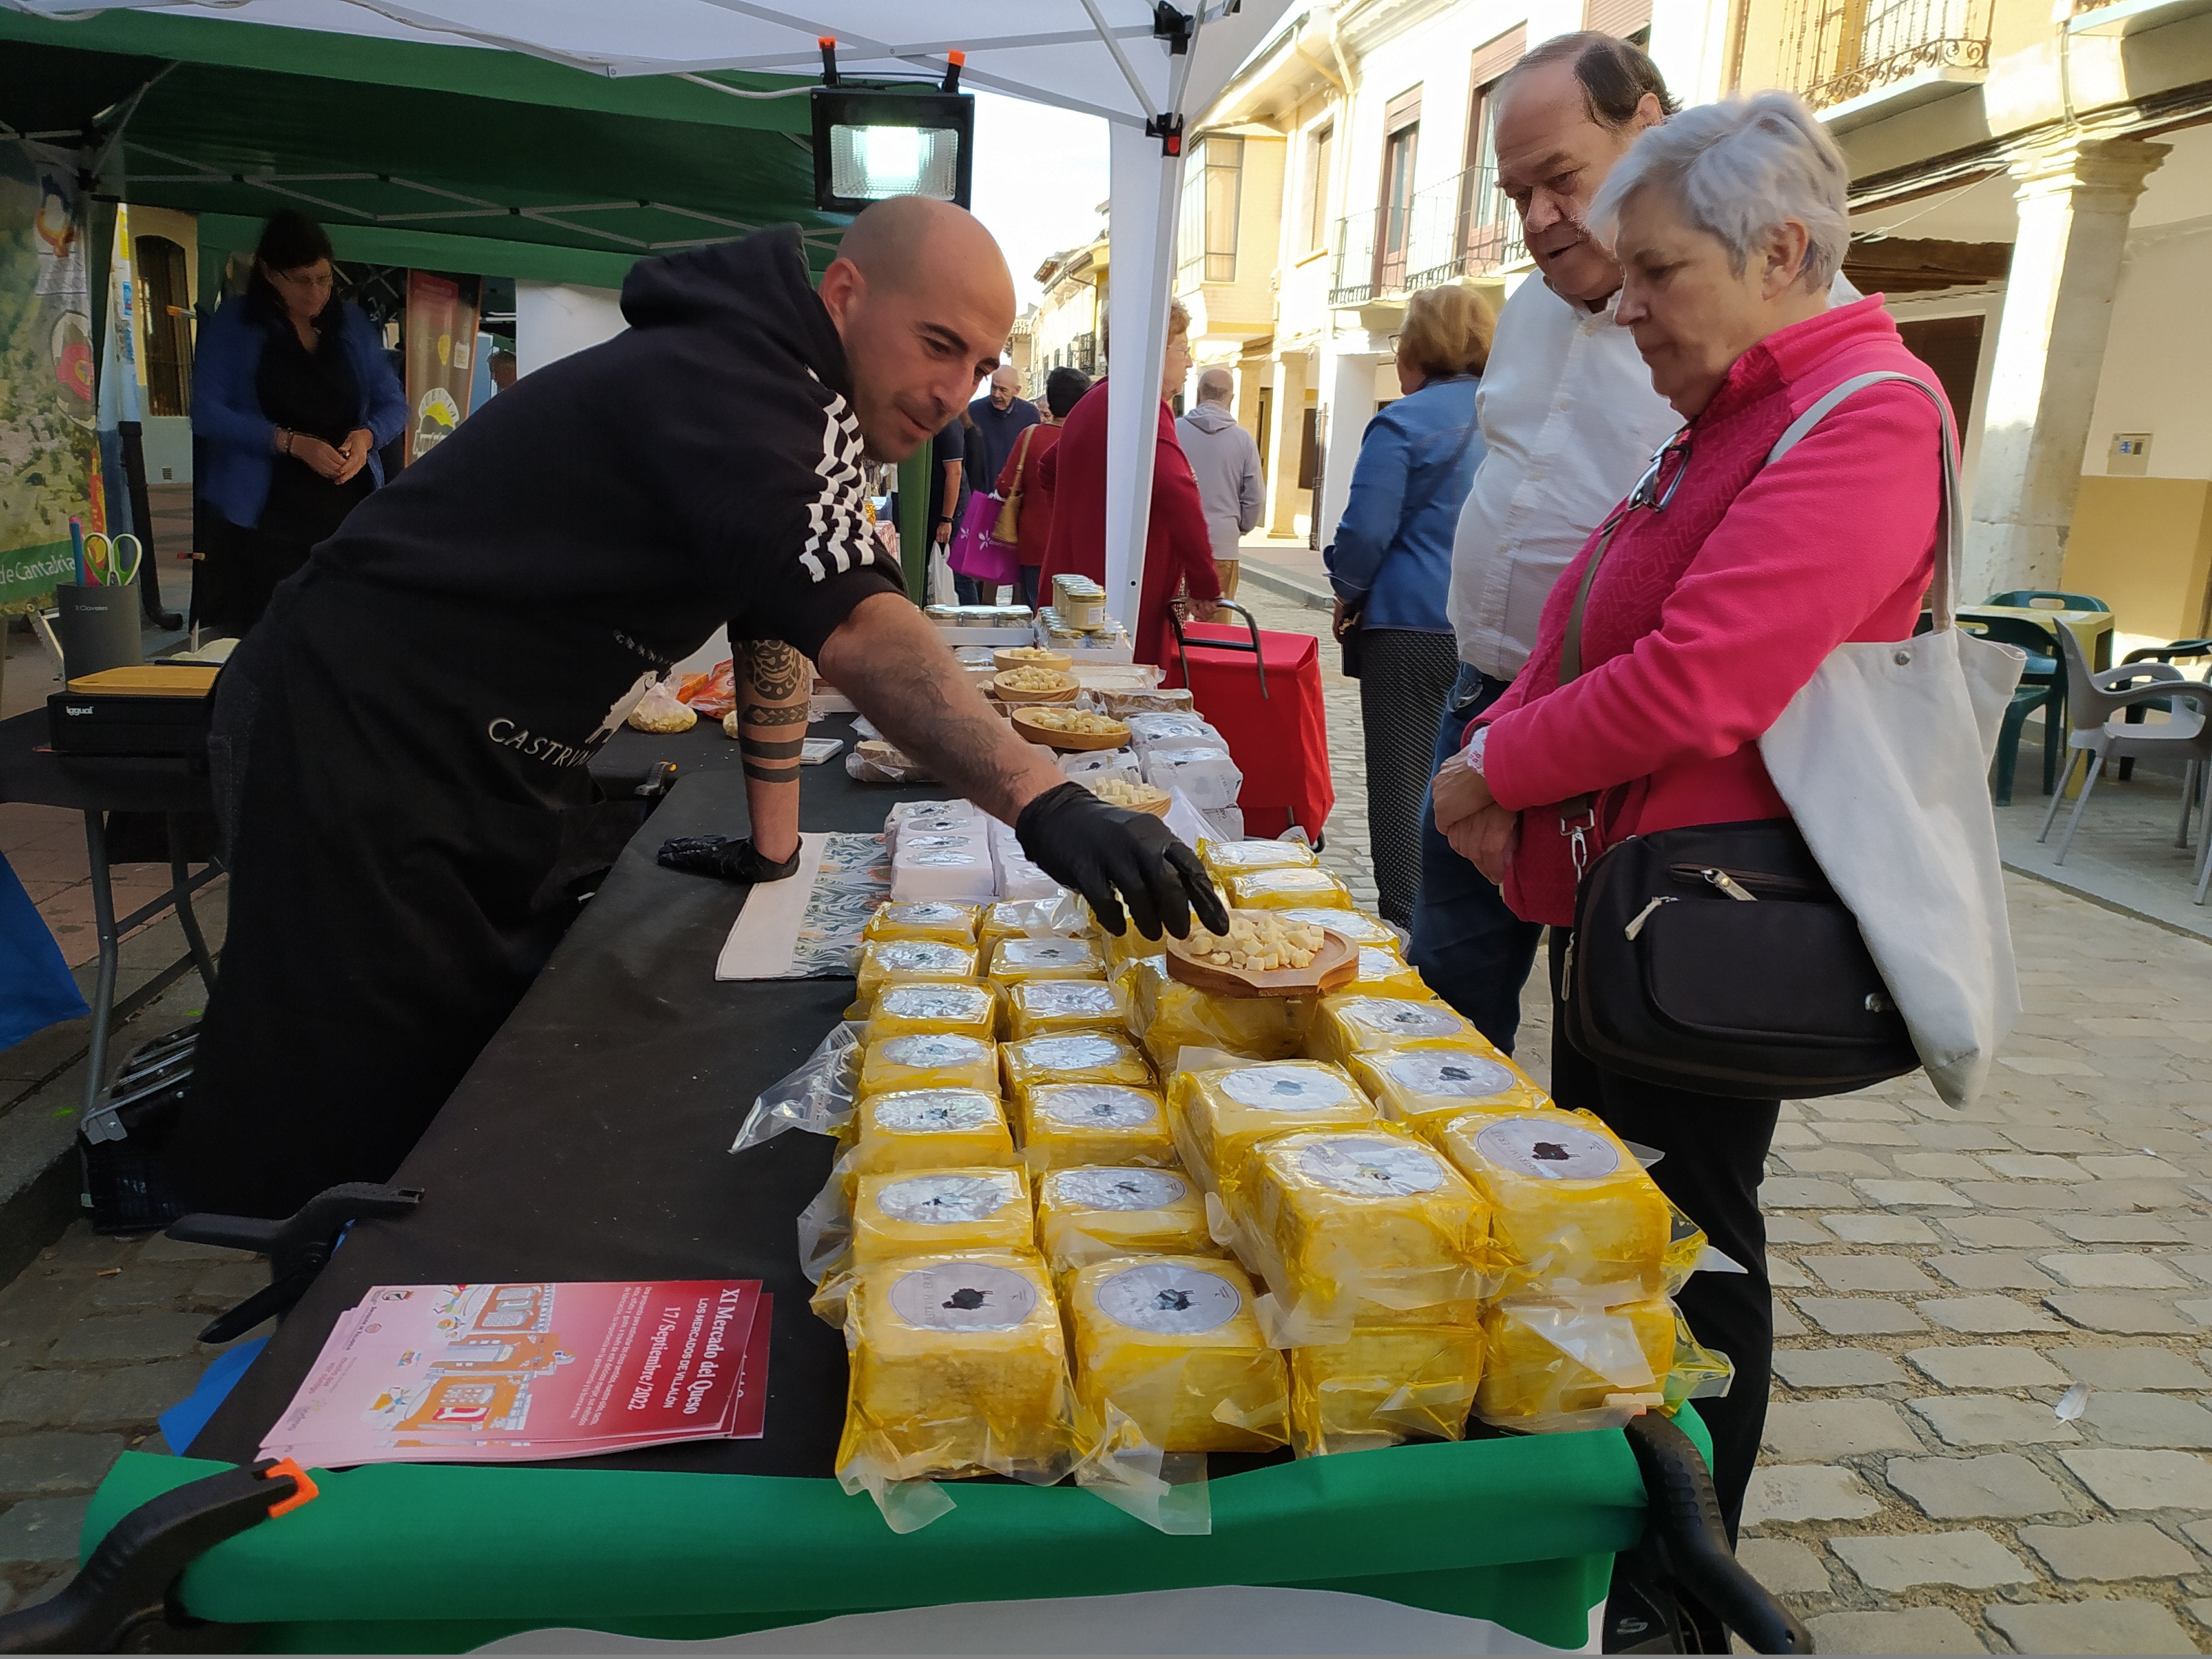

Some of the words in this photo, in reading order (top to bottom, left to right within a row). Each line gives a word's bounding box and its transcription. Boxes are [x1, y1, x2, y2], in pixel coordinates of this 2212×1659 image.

[15, 554, 75, 580] Cantabria
[66, 706, 94, 716] iggual
[719, 1288, 740, 1304] XI
[636, 1295, 648, 1316] propuesta
[696, 1298, 709, 1314] LOS
[632, 1316, 640, 1327] para
[614, 1333, 624, 1345] través
[625, 1327, 637, 1346] estimular
[681, 1314, 705, 1359] MERCADOS
[703, 1306, 736, 1359] Mercado
[607, 1353, 615, 1362] este
[617, 1354, 627, 1365] cinco
[627, 1307, 681, 1411] 17/Septiembre/2022
[677, 1359, 690, 1371] DE
[696, 1361, 719, 1378] del
[662, 1371, 686, 1408] VILLALÓN
[682, 1380, 713, 1415] Queso
